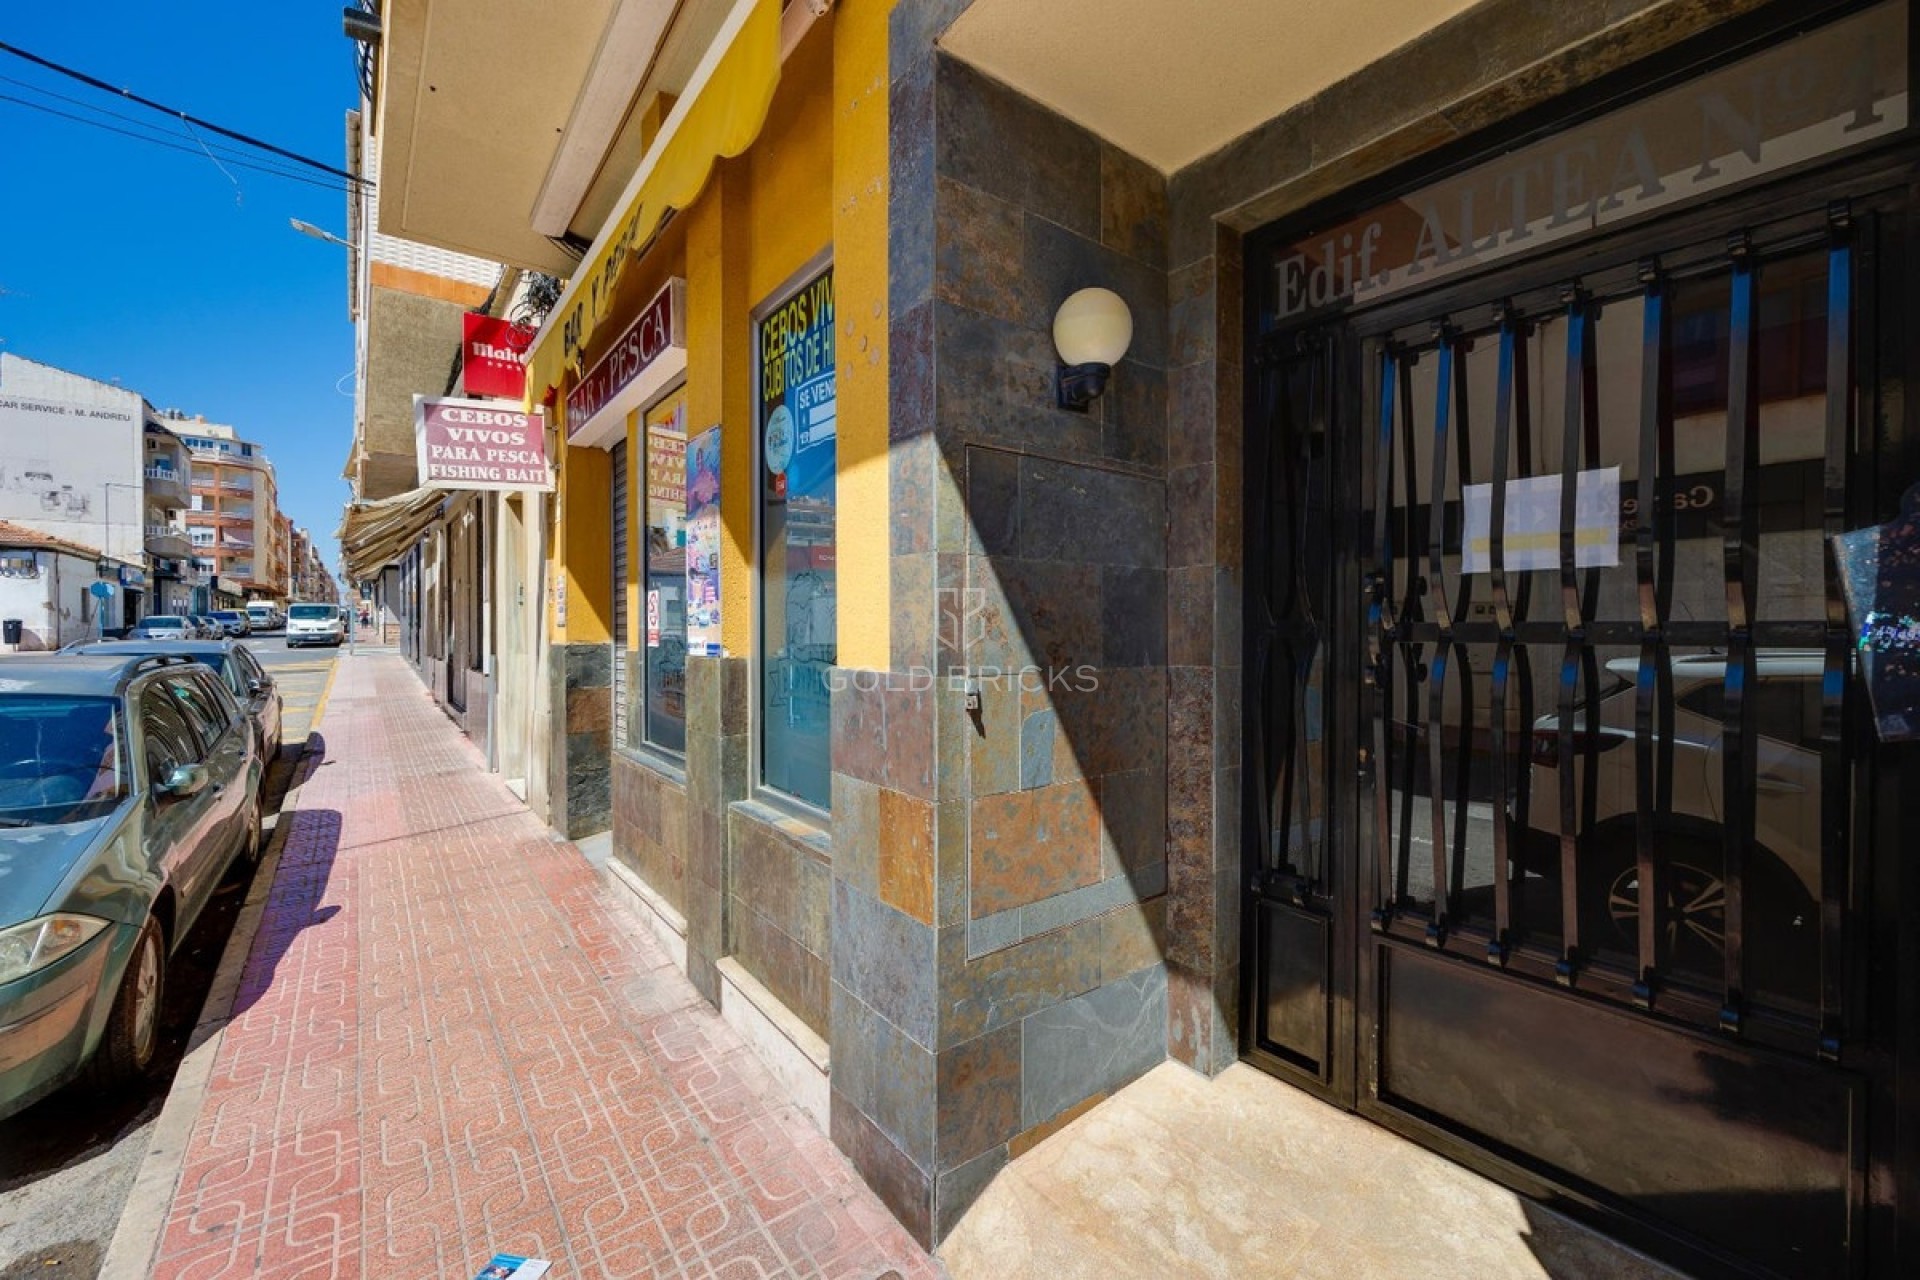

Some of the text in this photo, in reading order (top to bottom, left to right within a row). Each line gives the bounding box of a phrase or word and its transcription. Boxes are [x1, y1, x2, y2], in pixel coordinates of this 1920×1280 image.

[1274, 222, 1391, 321] Edif.
[1408, 124, 1666, 275] ALTEA
[762, 276, 835, 365] CEBOS VIV
[570, 380, 595, 432] BAR
[609, 302, 667, 396] PESCA
[763, 343, 804, 403] CUBITOS
[805, 332, 821, 379] DE
[799, 377, 836, 410] SE VEN
[20, 402, 65, 415] SERVICE
[90, 410, 131, 422] ANDREU
[440, 408, 529, 428] CEBOS
[447, 427, 526, 446] VIVOS
[430, 444, 541, 465] PARA PESCA
[429, 463, 545, 482] FISHING BAIT
